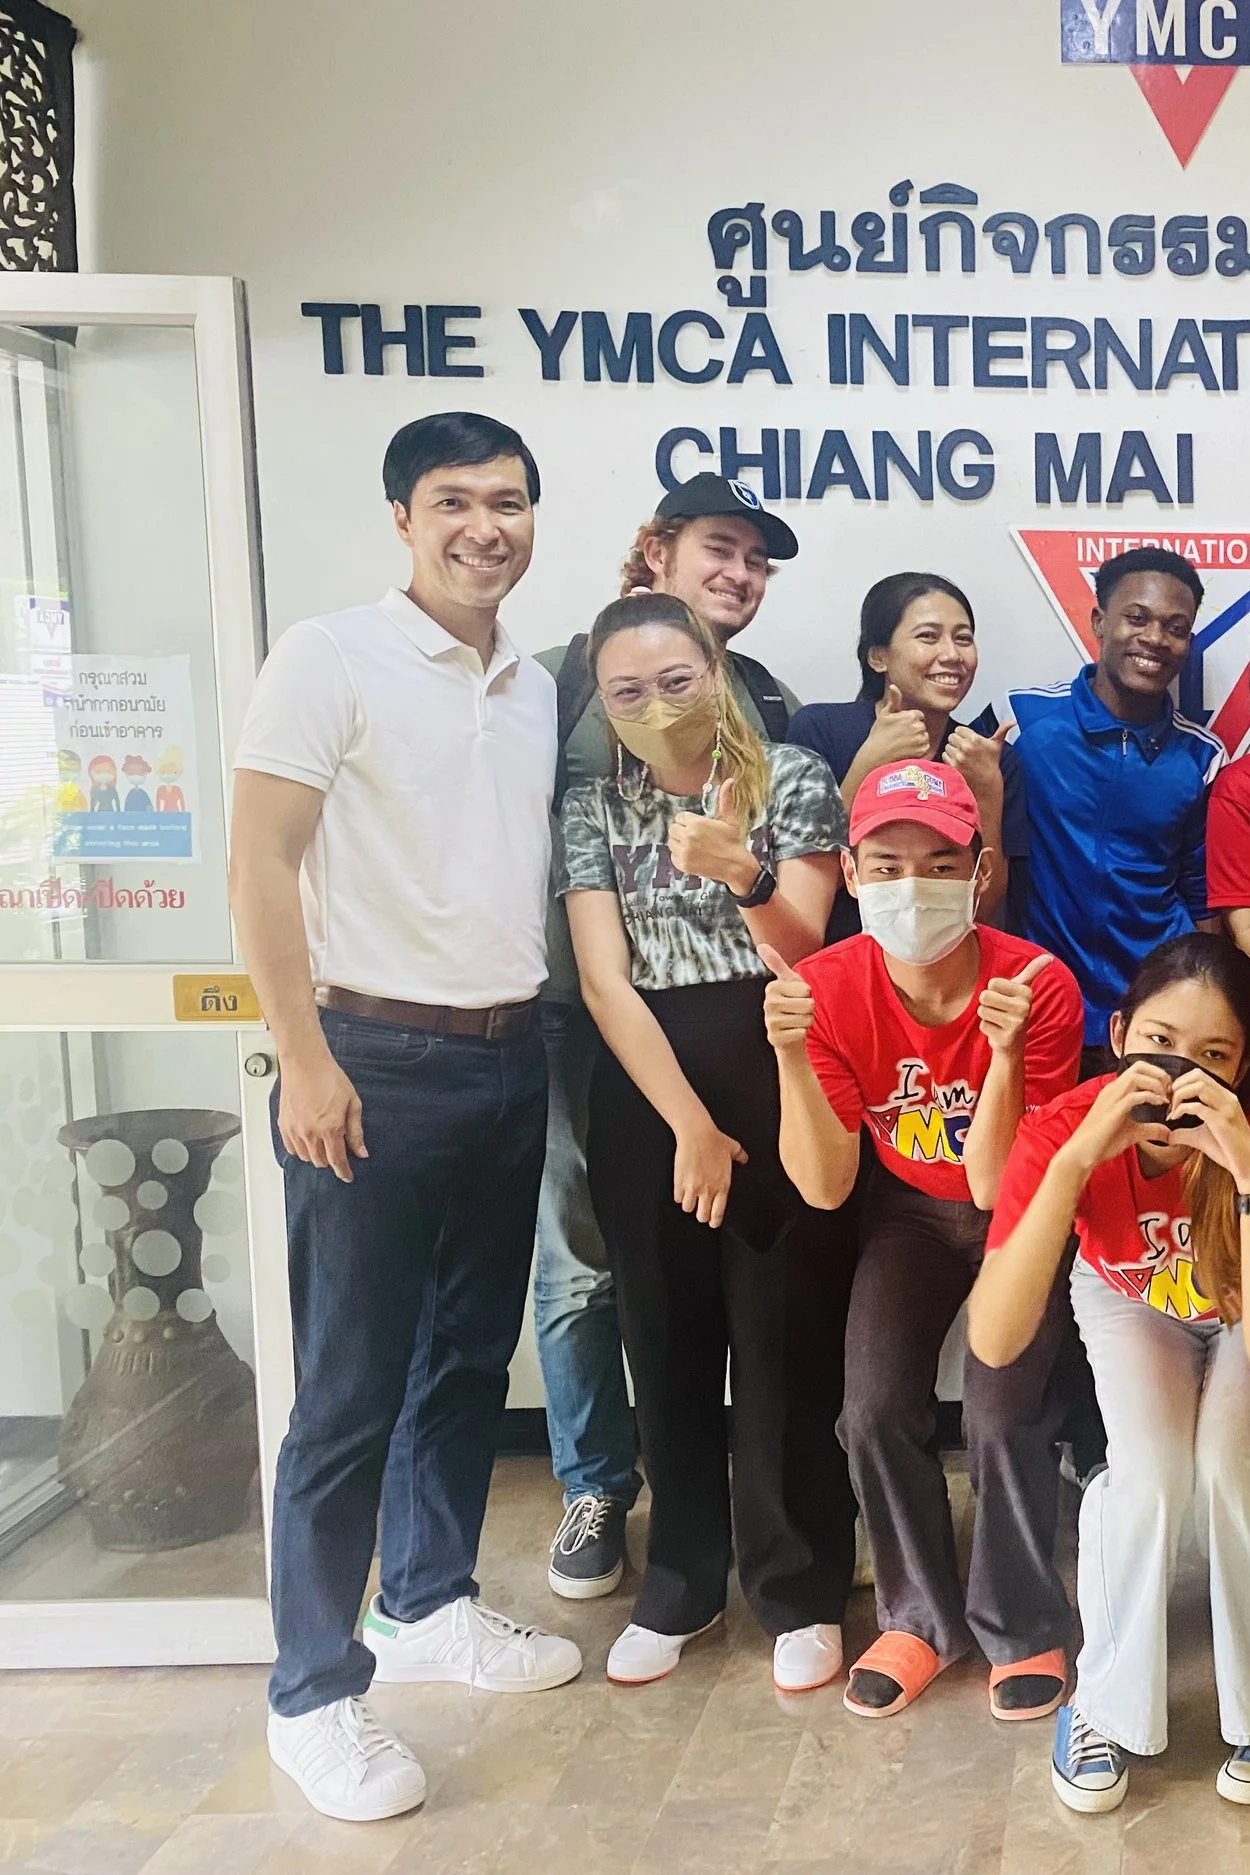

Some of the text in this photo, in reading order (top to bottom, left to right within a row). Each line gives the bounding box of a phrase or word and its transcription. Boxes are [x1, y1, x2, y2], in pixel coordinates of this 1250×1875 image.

[301, 302, 485, 378] THE
[518, 308, 793, 385] YMCA
[655, 427, 995, 501] CHIANG
[1034, 430, 1193, 504] MAI
[79, 671, 147, 690] กรุณาสวม
[70, 720, 163, 738] ก่อนเข้าอาคาร
[201, 985, 238, 1012] ดึง
[894, 1063, 924, 1100] I
[868, 1104, 973, 1163] YMC
[1139, 1218, 1166, 1260] I
